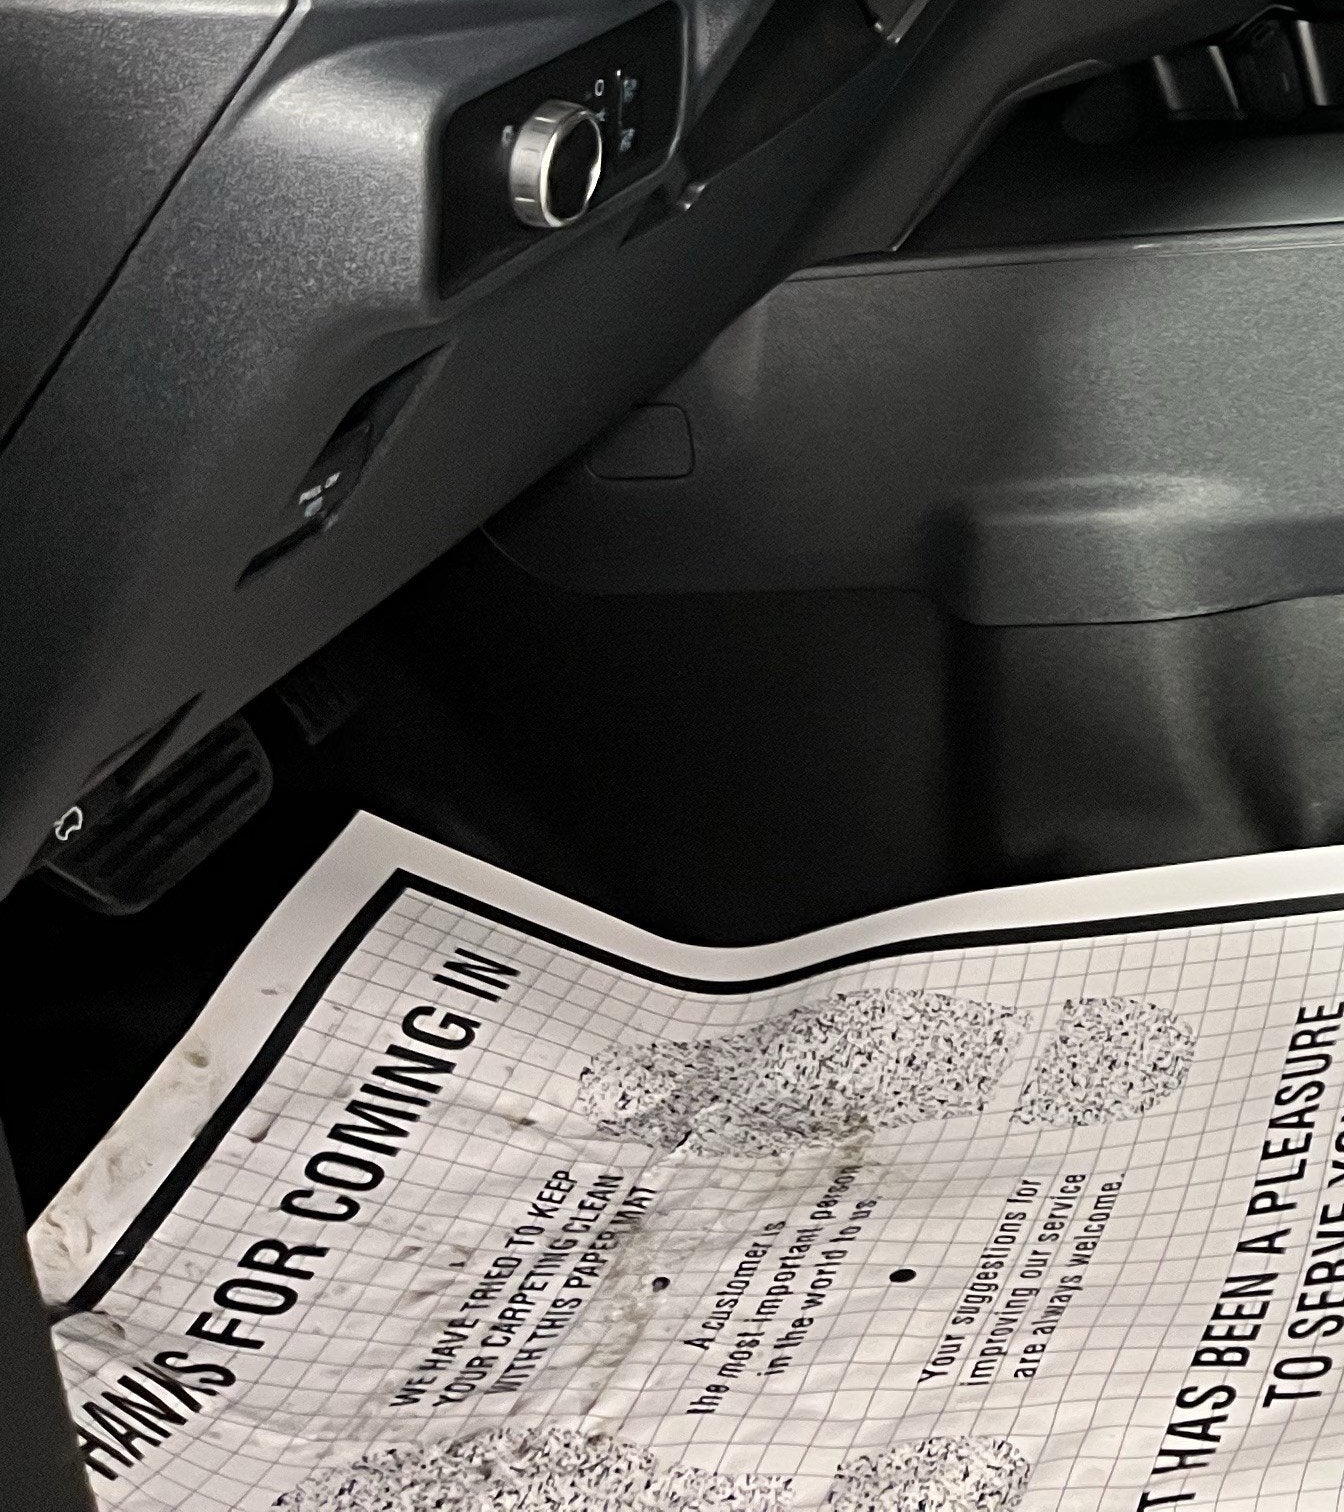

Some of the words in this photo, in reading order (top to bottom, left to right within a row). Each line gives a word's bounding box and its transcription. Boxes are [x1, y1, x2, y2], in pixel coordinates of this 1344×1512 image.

[76, 1350, 237, 1481] HANKS
[185, 1238, 329, 1351] FOR
[279, 1005, 483, 1223] COMING
[432, 947, 521, 1003] IN
[828, 1225, 862, 1243] to
[959, 1287, 1041, 1386] improving
[1019, 1249, 1052, 1279] our
[1037, 1173, 1087, 1242] service
[1013, 1342, 1047, 1379] are
[1031, 1274, 1083, 1336] always
[1066, 1173, 1125, 1268] welcome.
[1235, 1227, 1292, 1256] A
[389, 1375, 438, 1407] WE
[417, 1317, 480, 1372] HAVE
[460, 1255, 523, 1313] TRIED
[504, 1224, 546, 1249] TO
[527, 1169, 578, 1219] KEEP
[432, 1355, 499, 1407] YOUR
[480, 1238, 579, 1348] CARPETING
[561, 1174, 624, 1234] CLEAN
[483, 1346, 548, 1395] WITH
[524, 1297, 583, 1345] THIS
[563, 1230, 618, 1290] PAPER
[610, 1186, 656, 1226] MAT
[684, 1337, 716, 1351] A
[701, 1241, 773, 1332] customer
[752, 1220, 786, 1237] is
[686, 1383, 730, 1415] the
[717, 1331, 766, 1379] most
[743, 1226, 824, 1323] important
[810, 1165, 863, 1221] person
[773, 1316, 815, 1350] the
[800, 1249, 849, 1311] world
[917, 1333, 966, 1384] Your
[951, 1211, 1027, 1325] suggestions
[1006, 1179, 1042, 1204] for
[1190, 1272, 1280, 1367] BEEN
[756, 1356, 793, 1377] in
[1150, 1384, 1237, 1475] HAS
[1262, 1353, 1333, 1408] TO
